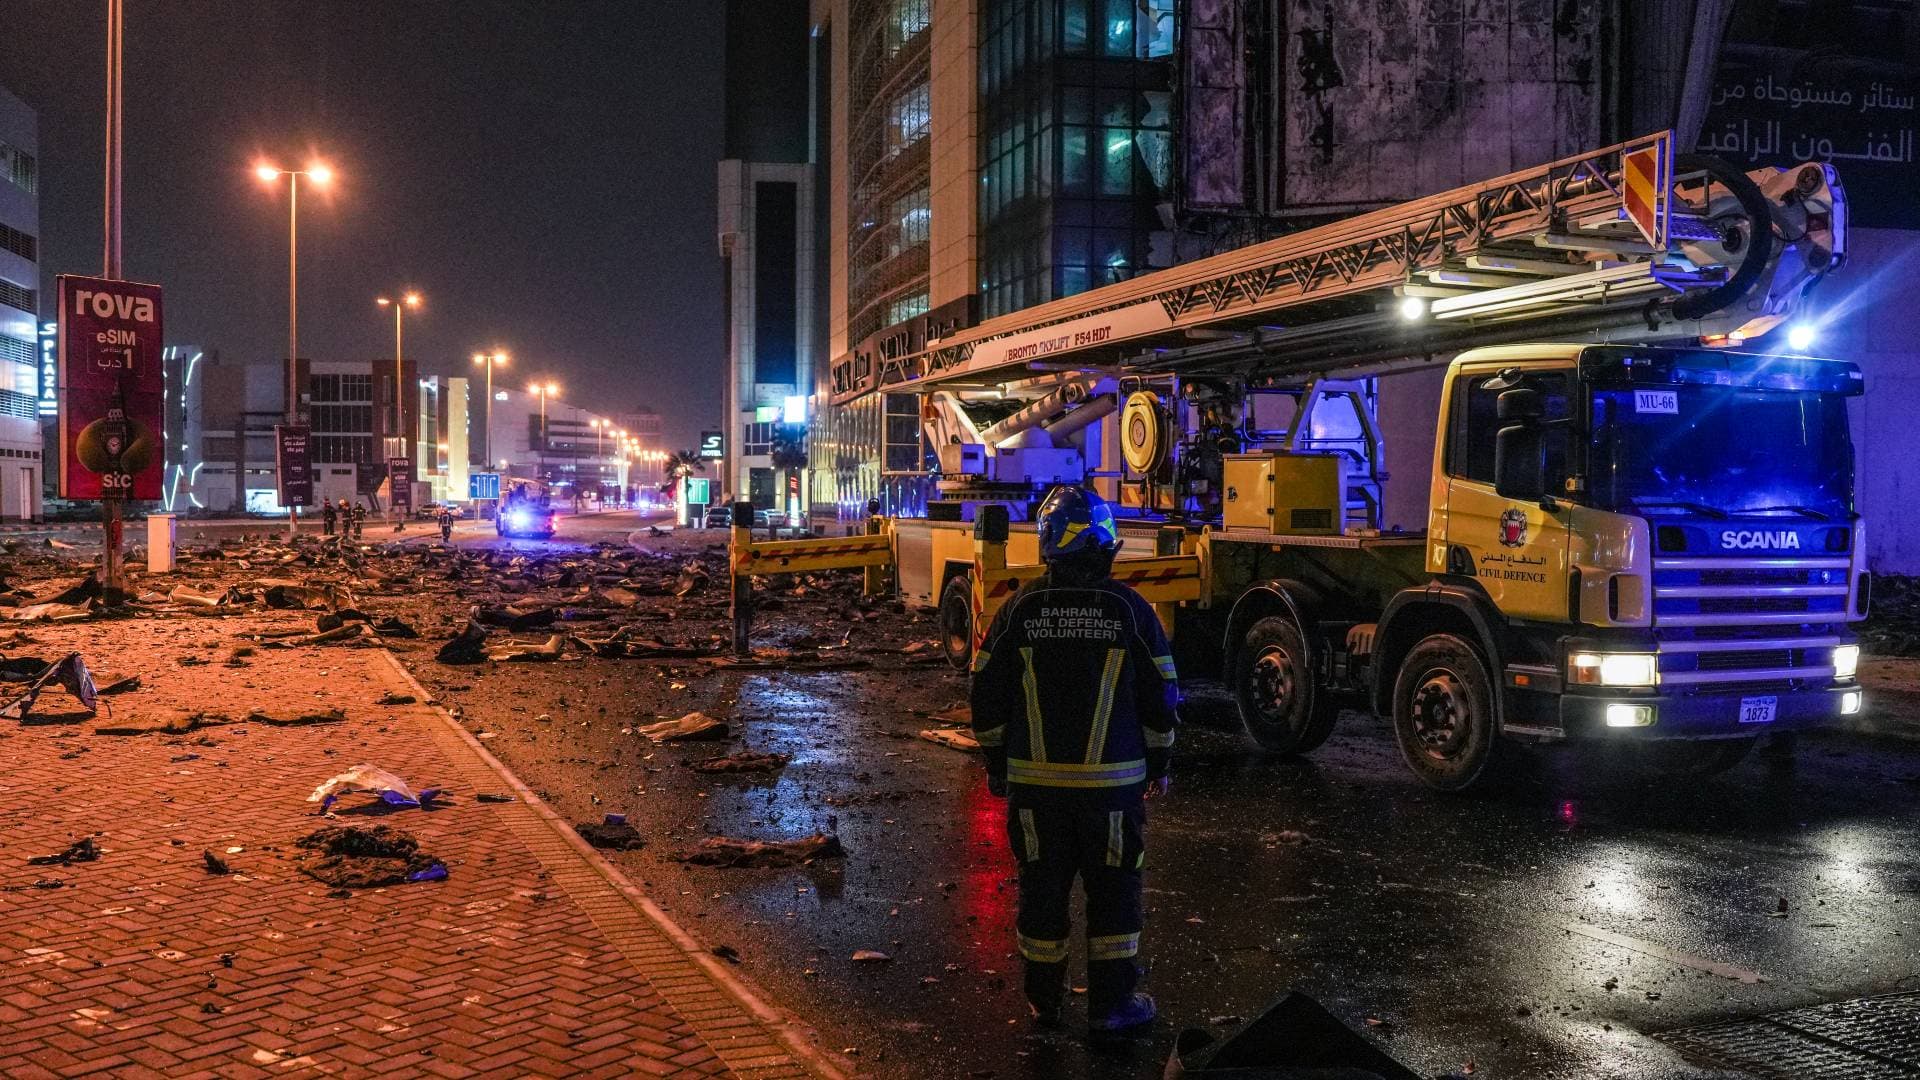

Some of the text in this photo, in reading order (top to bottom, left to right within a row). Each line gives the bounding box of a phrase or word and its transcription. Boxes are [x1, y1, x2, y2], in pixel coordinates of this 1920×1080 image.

[1753, 74, 1853, 109] مستوحاة
[1860, 81, 1915, 113] ستائر
[76, 289, 154, 322] rova
[96, 328, 136, 347] eSIM
[1007, 343, 1038, 361] BRONTO
[1074, 330, 1091, 346] F54
[1092, 325, 1112, 342] HDT
[123, 348, 132, 368] 1
[43, 339, 56, 399] PLAZA
[1640, 394, 1674, 409] MU-66
[701, 449, 723, 457] HOTEL
[1721, 530, 1800, 549] SCANIA
[1479, 567, 1547, 583] CIVIL DEFENCE
[1041, 607, 1103, 617] BAHRAIN
[1024, 618, 1122, 630] CIVIL DEFENCE
[1027, 629, 1116, 640] (VOLUNTEER)
[1745, 707, 1770, 720] 1873
